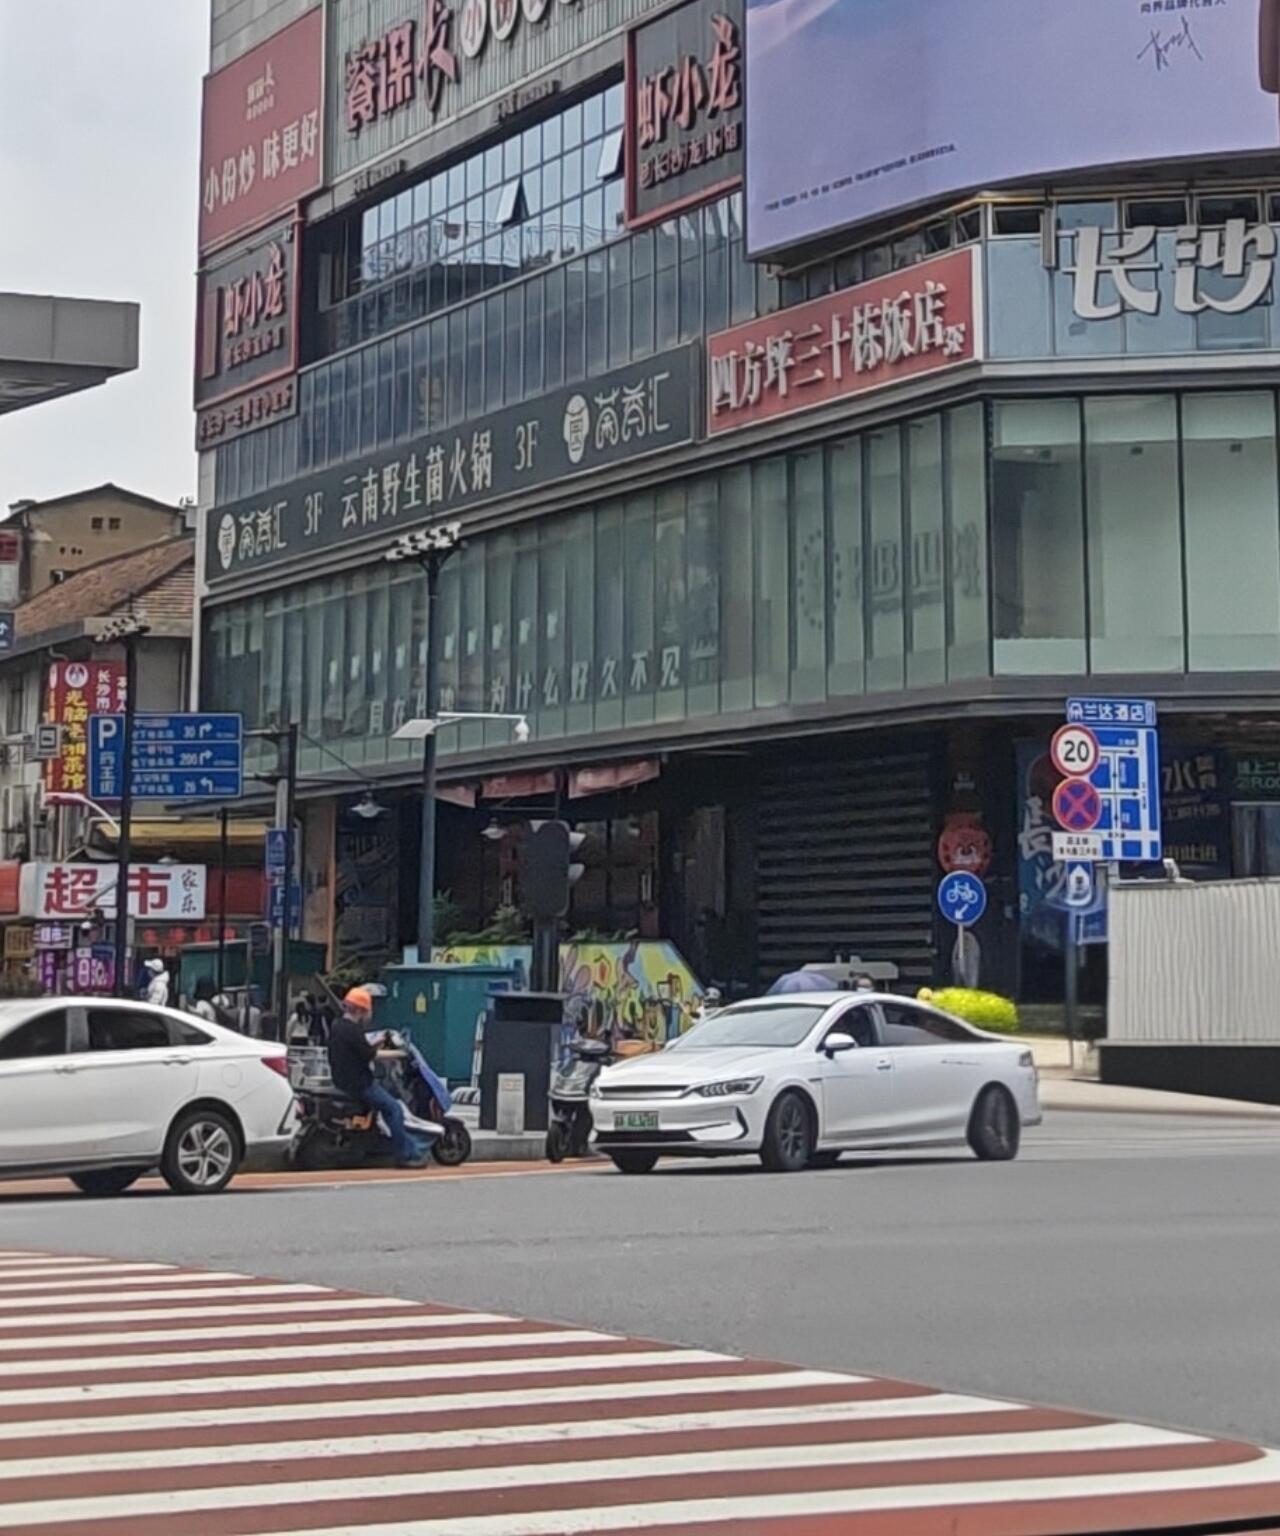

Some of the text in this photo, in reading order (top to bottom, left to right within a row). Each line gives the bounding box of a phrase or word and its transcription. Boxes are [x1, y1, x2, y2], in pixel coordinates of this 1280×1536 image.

[637, 15, 740, 150] 虾小龙
[710, 280, 948, 415] 四方坪三十栋饭店
[341, 430, 493, 529] 云南野生菌火锅
[491, 646, 681, 713] 为什么好久不见
[98, 719, 117, 749] P
[1063, 740, 1090, 763] 20
[43, 867, 172, 916] 超市
